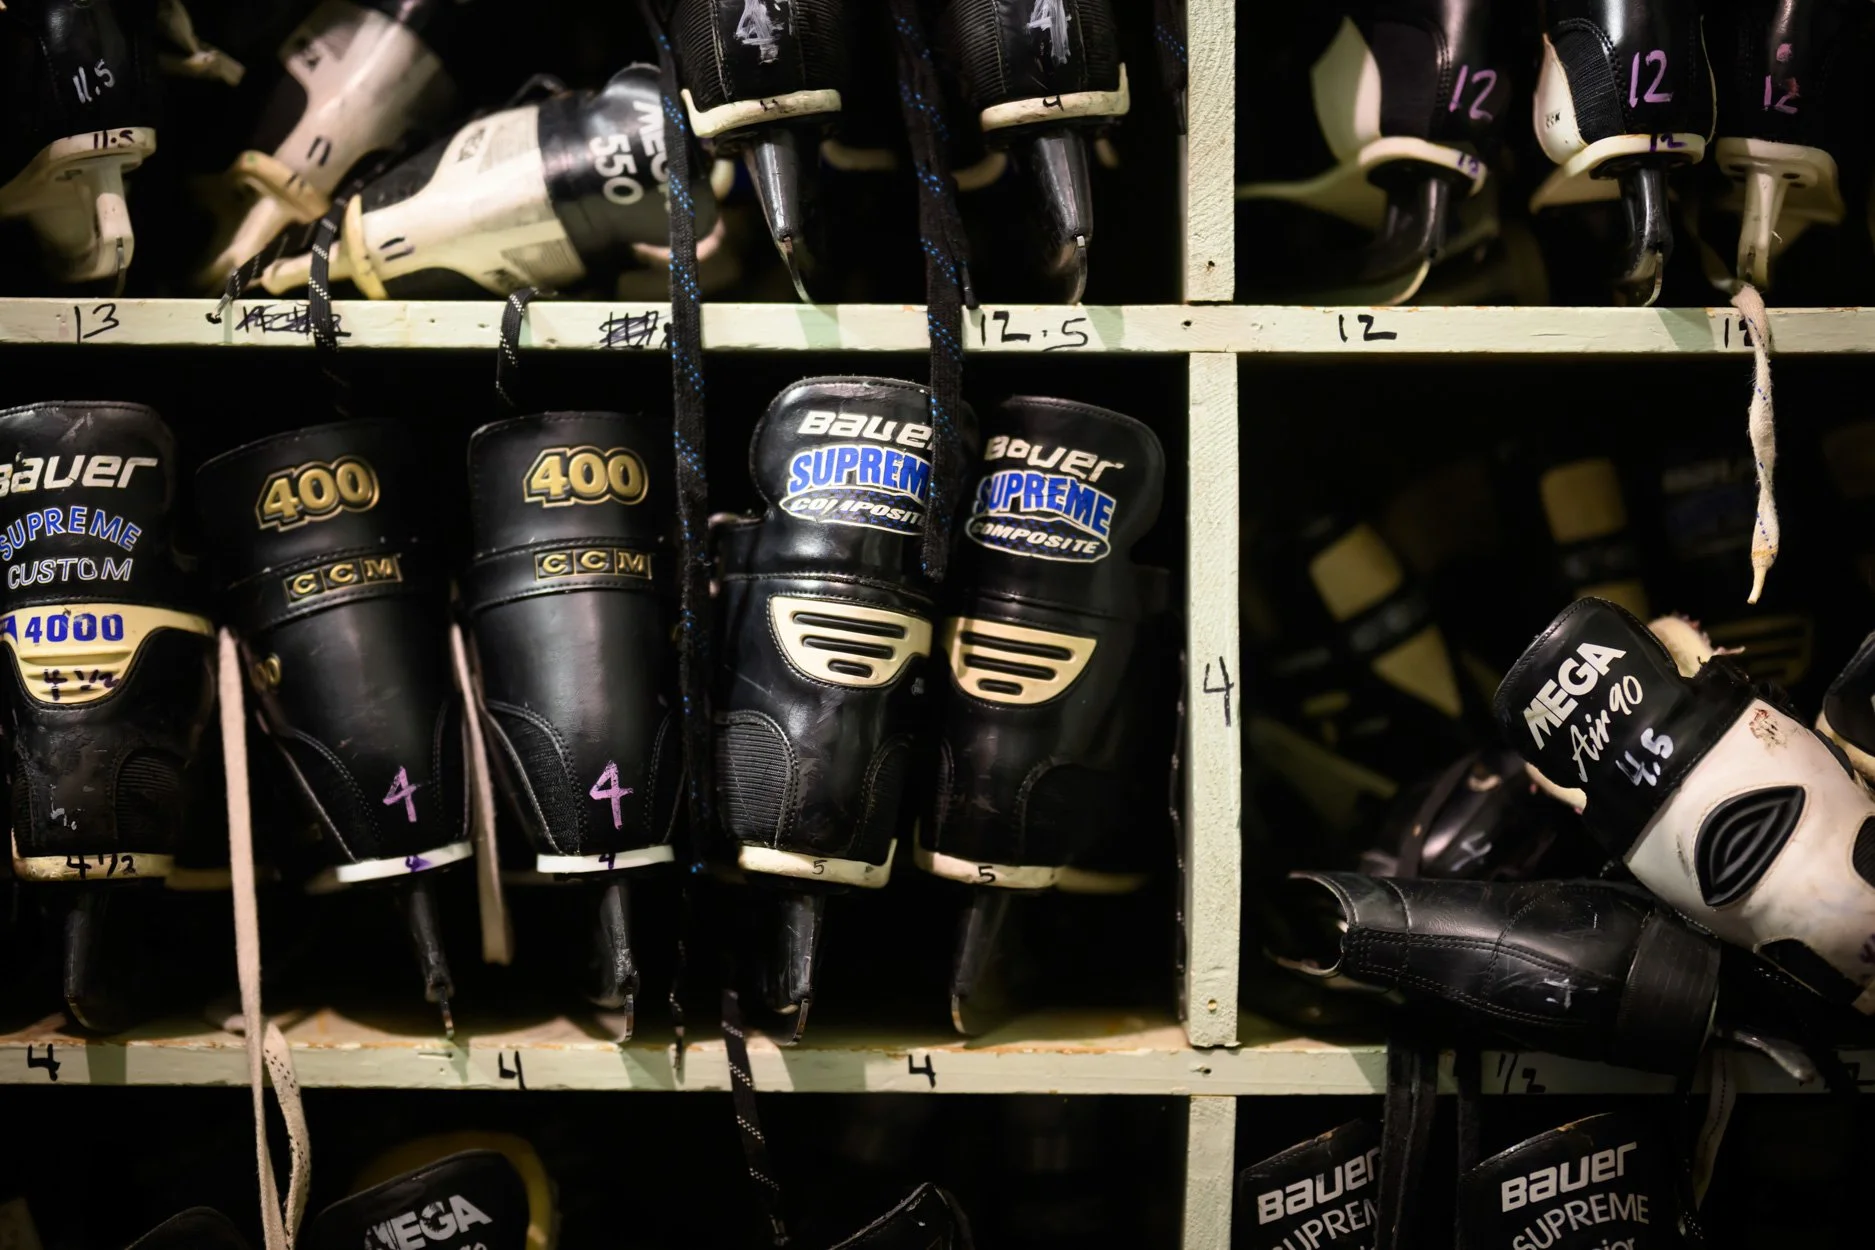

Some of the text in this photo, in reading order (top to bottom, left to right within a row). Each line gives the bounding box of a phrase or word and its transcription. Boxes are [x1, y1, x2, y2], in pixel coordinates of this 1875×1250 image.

[73, 60, 115, 103] 11.5
[1448, 66, 1497, 121] 12
[1630, 50, 1673, 107] 12
[1042, 95, 1065, 112] 4
[94, 130, 135, 150] 11.5
[1650, 133, 1689, 153] 12
[589, 134, 646, 206] 550
[75, 303, 120, 343] 13
[1338, 314, 1398, 344] 12
[798, 410, 935, 451] Baue
[527, 450, 646, 503] 400
[786, 443, 935, 503] SUPREM
[983, 434, 1124, 482] Bauer
[259, 458, 377, 528] 400
[788, 497, 927, 526] COMPOSIT
[975, 469, 1117, 541] SUPREME
[0, 505, 142, 561] SUPREME
[970, 520, 1100, 556] COMPOSITE
[7, 557, 133, 590] CUSTOM
[290, 557, 394, 597] CCM
[541, 550, 647, 576] CCM
[24, 613, 125, 644] 4000
[1203, 657, 1235, 727] 4
[1523, 642, 1627, 750] MEGA
[382, 765, 420, 823] 4
[589, 760, 634, 829] 4
[66, 854, 92, 879] 4
[598, 853, 616, 870] 4
[812, 859, 826, 876] 5
[978, 865, 996, 885] 5
[28, 1043, 61, 1081] 4
[498, 1051, 527, 1091] 4
[909, 1054, 937, 1089] 4
[1257, 1148, 1380, 1226] Bauer
[1500, 1142, 1637, 1214] Bauer
[363, 1194, 494, 1250] MEGA
[1270, 1197, 1380, 1250] UPRE
[1512, 1193, 1649, 1250] SUPREME
